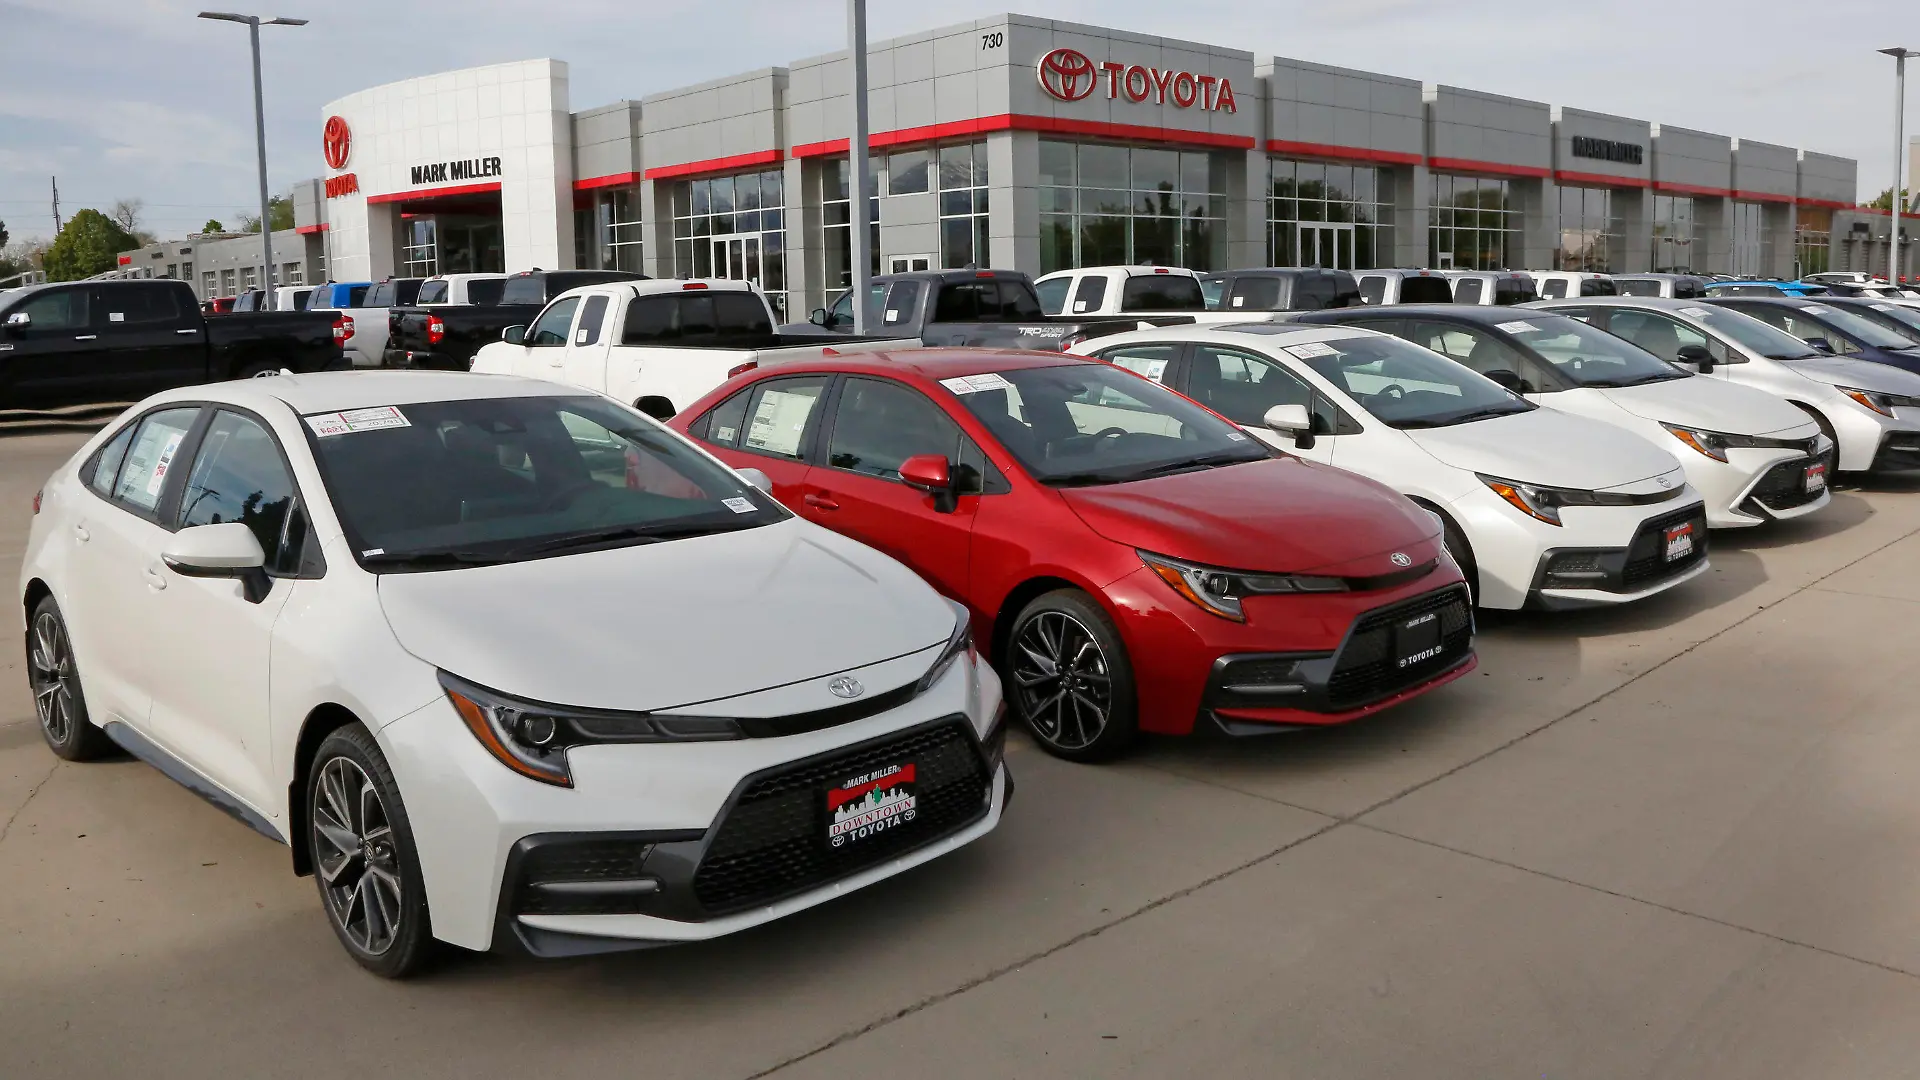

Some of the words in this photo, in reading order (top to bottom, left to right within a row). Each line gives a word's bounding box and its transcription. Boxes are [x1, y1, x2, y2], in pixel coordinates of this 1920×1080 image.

[982, 32, 1003, 50] 730
[1100, 61, 1237, 114] TOYOTA
[411, 163, 448, 185] MARK
[450, 157, 502, 180] MILLER
[325, 173, 359, 199] TOYOTA
[1018, 327, 1042, 336] TRD
[1408, 648, 1434, 665] TOYOTA
[846, 773, 870, 789] MARK
[870, 765, 898, 781] MILLER
[832, 800, 912, 836] DOWNTOWN
[849, 815, 901, 841] TOYOTA
